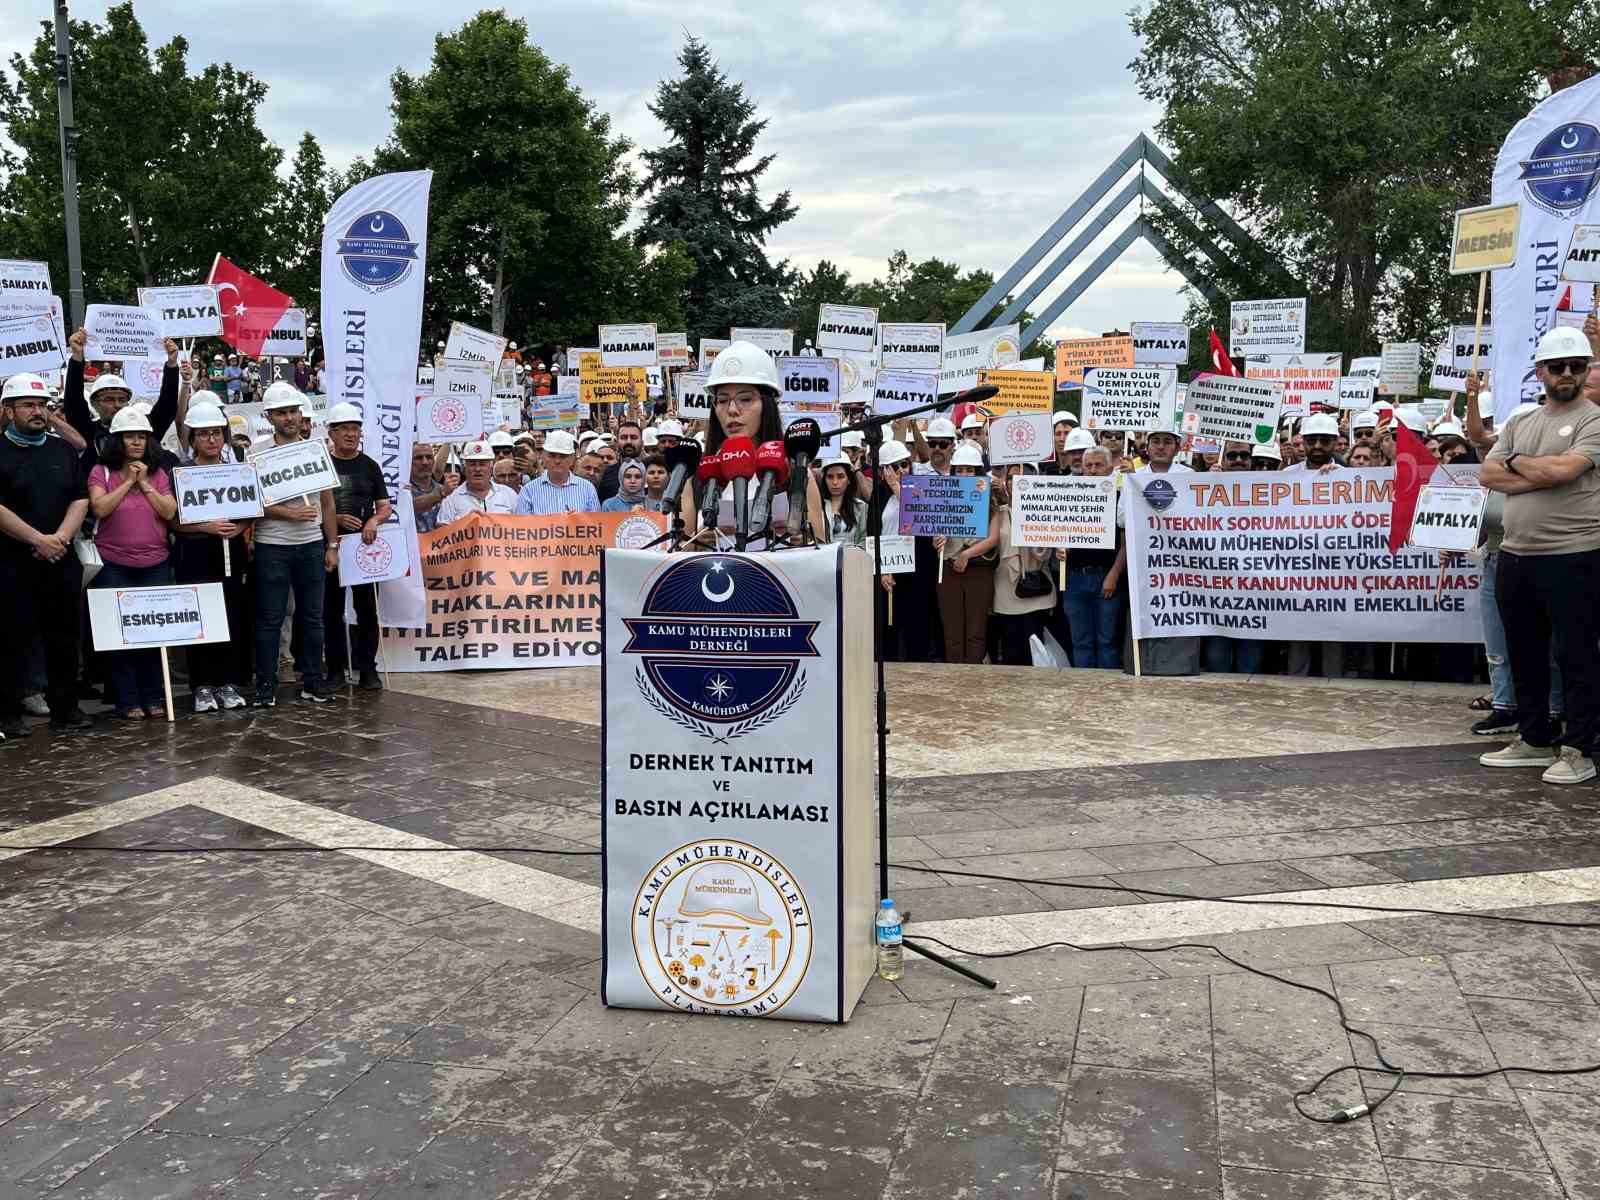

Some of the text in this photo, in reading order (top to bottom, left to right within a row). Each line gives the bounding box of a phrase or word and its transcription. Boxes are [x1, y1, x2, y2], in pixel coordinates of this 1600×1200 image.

[1456, 228, 1513, 254] MERSİN
[1568, 248, 1600, 262] ANT
[2, 279, 48, 290] SAKARYA
[820, 324, 874, 336] ADIYAMAN
[602, 342, 654, 352] KARAMAN
[883, 342, 940, 353] DİYARBAKIR
[1134, 340, 1186, 350] ANTALYA
[1456, 344, 1492, 356] BAR
[784, 372, 829, 392] IĞDIR
[1097, 371, 1160, 380] UZUN OLUR
[449, 382, 477, 394] İZMİR
[1098, 380, 1161, 388] DEMİRYOLU
[876, 388, 934, 402] MALATYA
[1106, 389, 1152, 398] RAYLARI
[1136, 410, 1160, 418] YOK
[1104, 418, 1145, 427] AYRANI
[260, 456, 328, 488] KOCAELİ
[183, 486, 256, 507] AFYON
[1046, 494, 1108, 502] MÜHENDİSLERİ
[1190, 476, 1396, 507] TALEPLERİM
[1021, 503, 1105, 514] MİMARLARI VE ŞEHİR
[1026, 514, 1101, 523] BÖLGE PLANCILARI
[1148, 512, 1390, 531] 1) TEKNİK SORUMLULUK ÖDE
[1416, 512, 1478, 528] ANTALYA
[432, 528, 474, 550] KAMU
[478, 522, 602, 541] MÜHENDİSLERİ
[920, 526, 976, 536] ALAMIYORUZ
[1050, 525, 1105, 534] SORUMLULUK
[1024, 534, 1100, 544] TAZMİNATI İSTİYOR
[1149, 535, 1164, 551] 2)
[1168, 536, 1216, 551] KAMU
[1220, 533, 1318, 551] MÜHENDİSİ
[486, 546, 501, 558] VE
[504, 544, 538, 560] ŞEHİR
[540, 544, 605, 557] PLANCILAR
[1148, 554, 1239, 570] MESLEKLER
[1243, 553, 1340, 570] SEVİYESİNE
[424, 568, 600, 590] ZLÜK VE MA
[1150, 574, 1164, 590] 3)
[1169, 573, 1234, 590] MESLEK
[1238, 576, 1358, 591] KANUNUNUN
[1150, 591, 1465, 612] 4) TÜM KAZANIMLARIN EMEKLİLİĞE
[122, 608, 200, 628] ESKİŞEHİR
[1151, 612, 1267, 630] YANSITILMASI
[648, 625, 792, 638] KAMU MÜHENDİSLERİ
[415, 638, 601, 662] TALEP EDİYO
[689, 640, 748, 652] DERNEĞİ
[691, 700, 750, 716] KAMÜHDER
[630, 753, 813, 775] DERNEK TANITIM
[712, 780, 730, 792] VE
[615, 799, 829, 822] BASIN AÇIKLAMASI
[638, 845, 809, 929] KAMU MÜHENDİSLERİ
[712, 878, 735, 886] KAMU
[662, 986, 778, 1016] PLATFORMU
